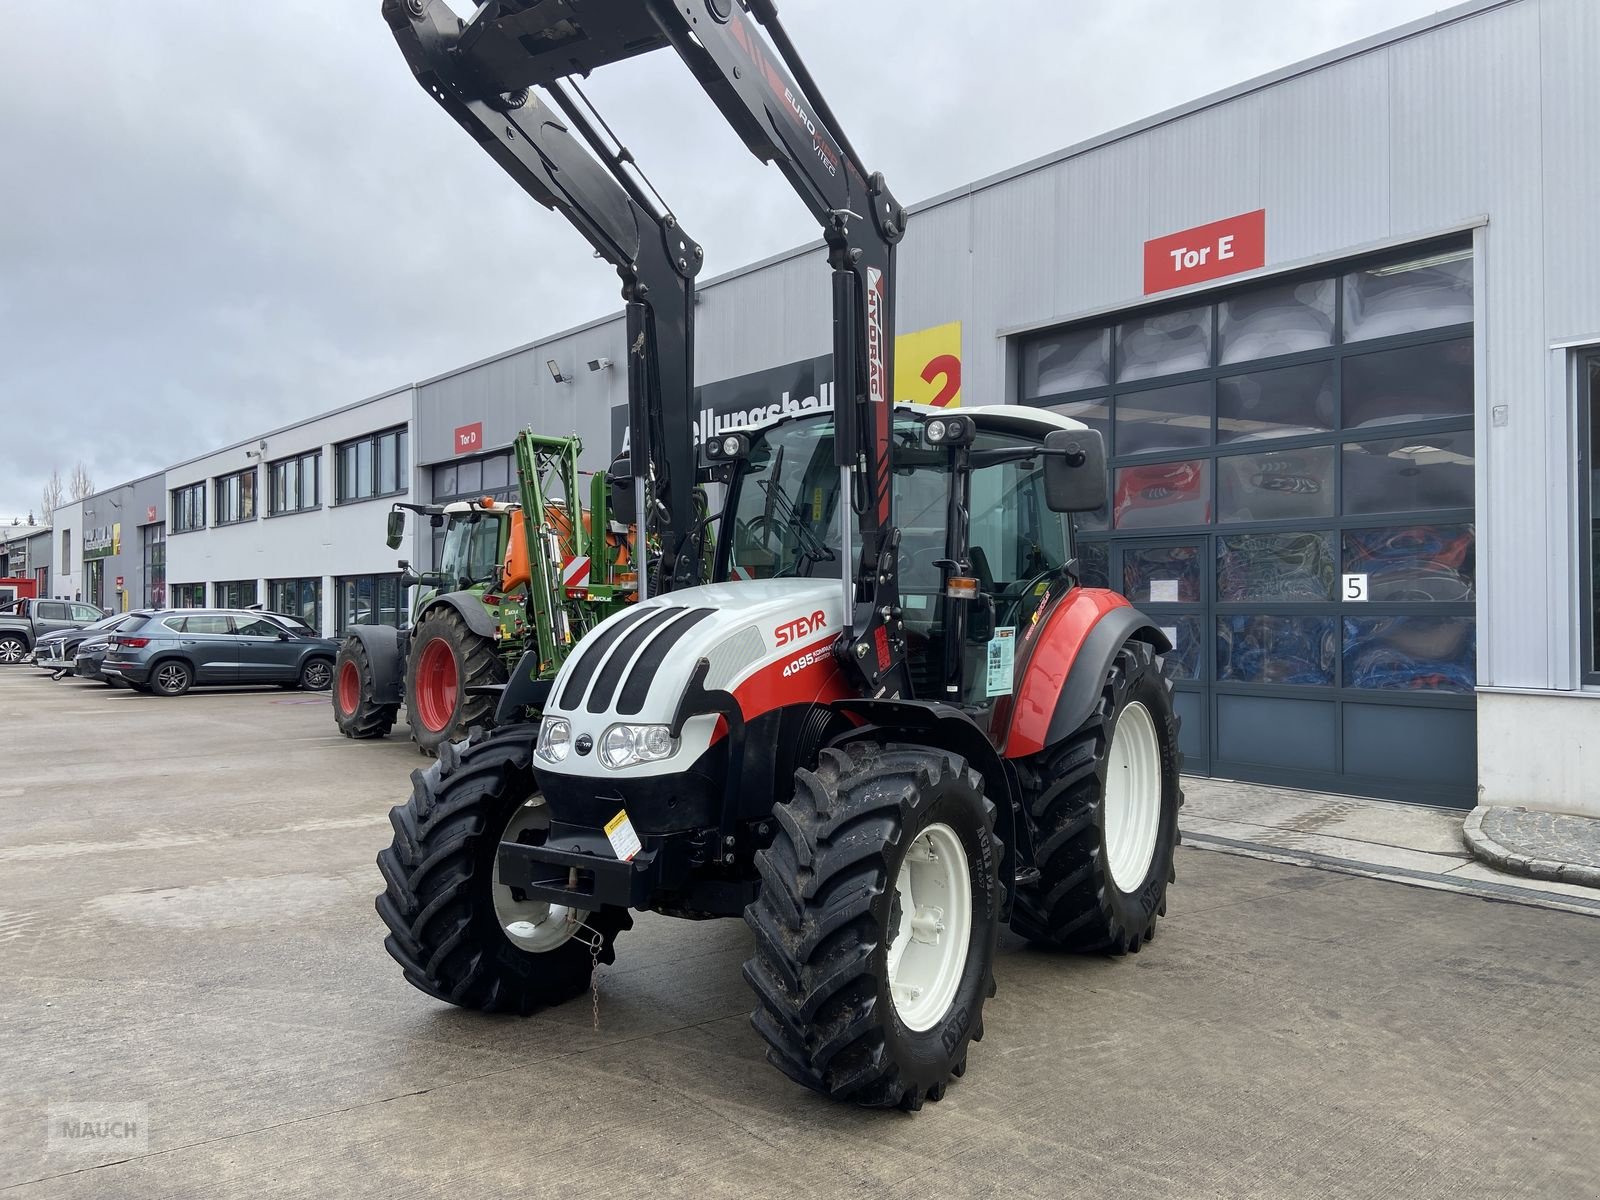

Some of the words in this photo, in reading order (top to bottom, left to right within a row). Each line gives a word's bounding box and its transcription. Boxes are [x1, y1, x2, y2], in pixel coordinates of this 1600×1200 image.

[812, 138, 837, 177] VITEC
[1170, 246, 1210, 272] Tor
[1218, 235, 1234, 260] E
[868, 289, 879, 395] HYDRAC
[920, 354, 962, 407] 2
[460, 434, 470, 446] Tor
[471, 431, 477, 443] D
[1347, 578, 1361, 598] 5
[774, 609, 827, 648] STEYR
[782, 652, 814, 678] 4095
